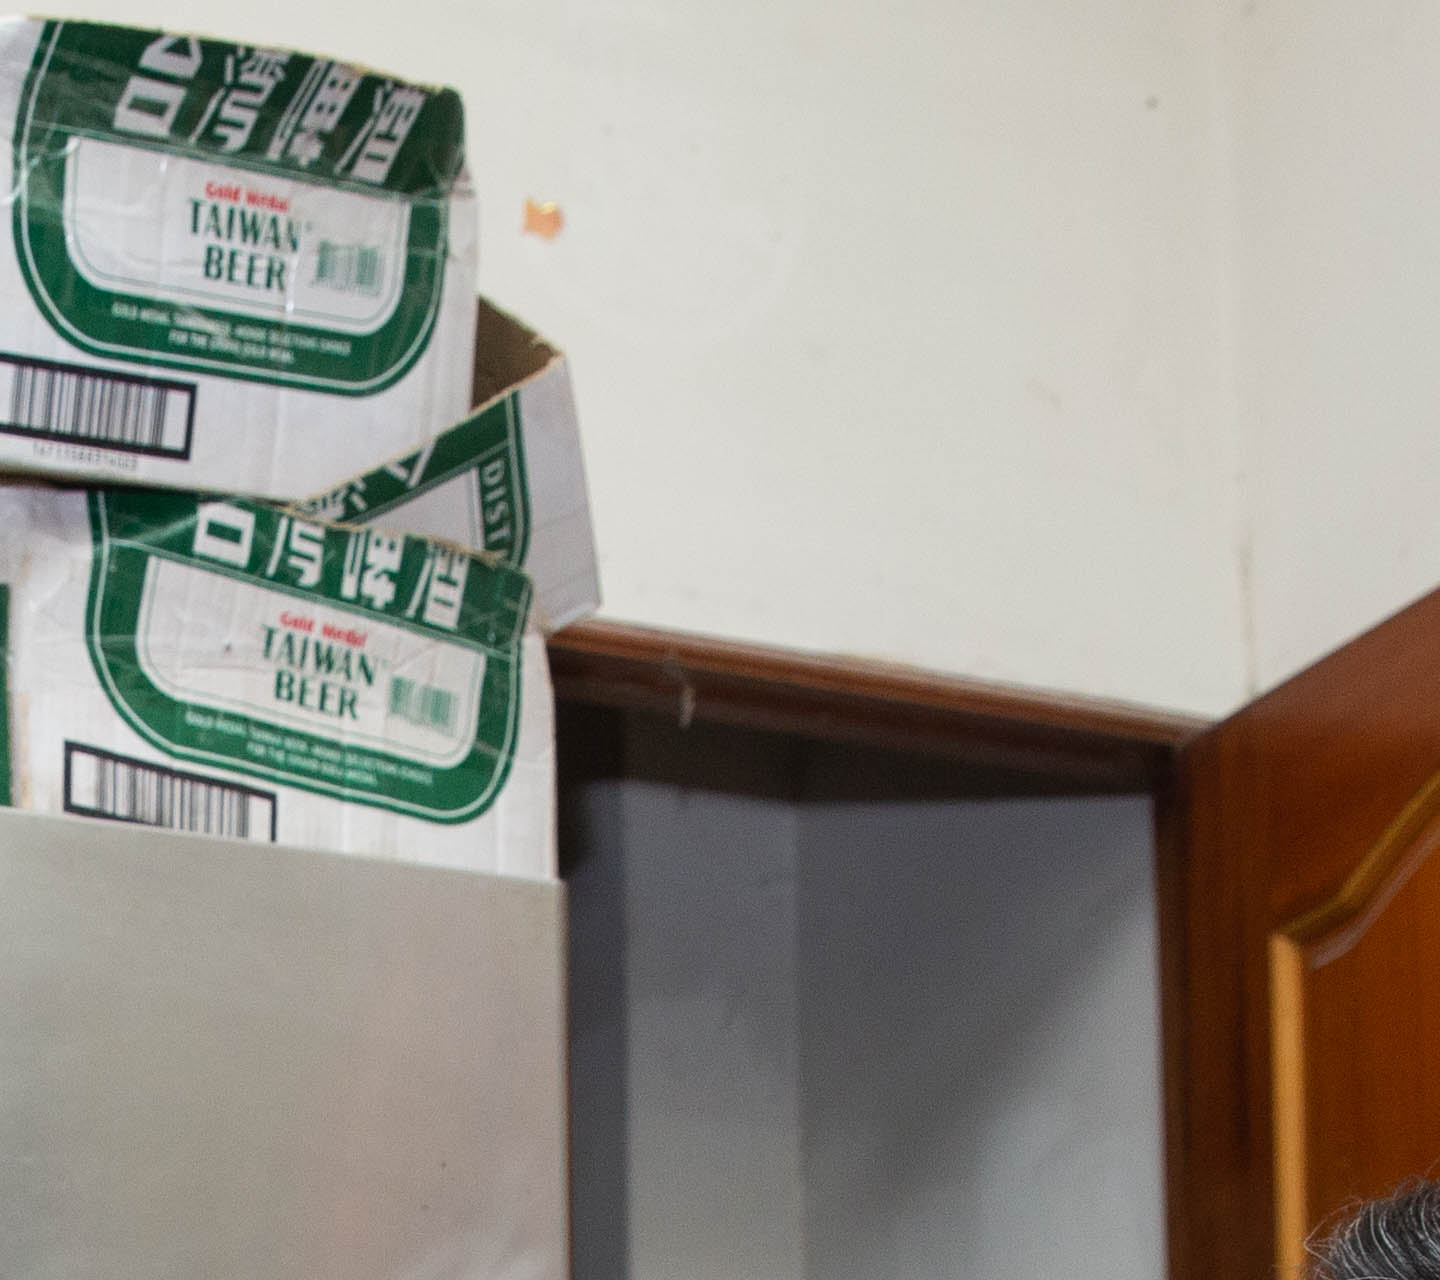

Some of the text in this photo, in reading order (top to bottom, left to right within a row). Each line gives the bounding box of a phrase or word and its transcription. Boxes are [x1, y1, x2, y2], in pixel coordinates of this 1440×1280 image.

[189, 199, 301, 253] TAIWAN
[203, 244, 287, 292] BEER
[262, 624, 378, 687] TAIWAN
[273, 668, 361, 721] BEER
